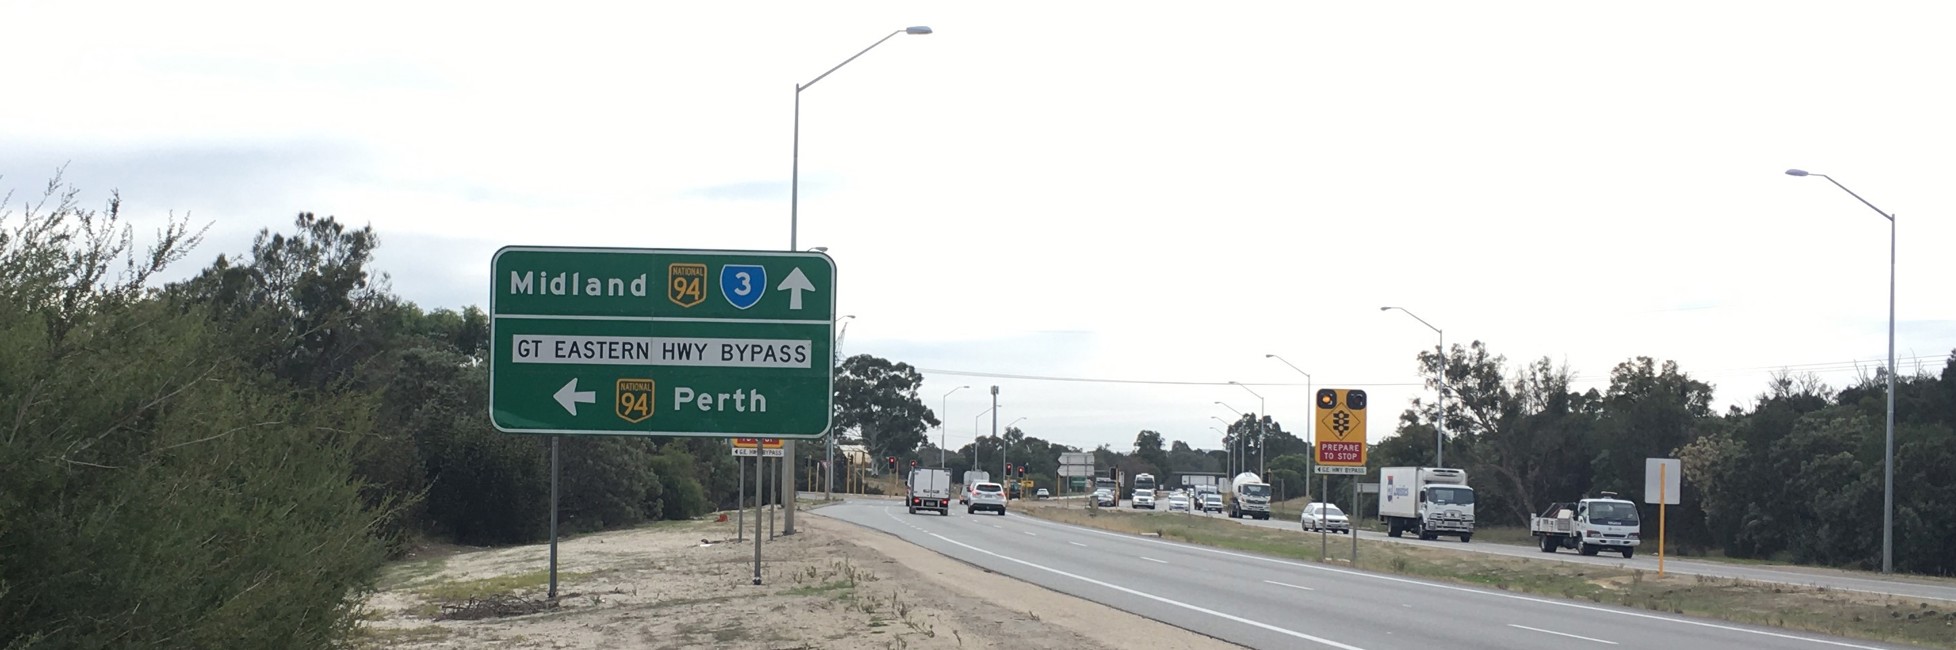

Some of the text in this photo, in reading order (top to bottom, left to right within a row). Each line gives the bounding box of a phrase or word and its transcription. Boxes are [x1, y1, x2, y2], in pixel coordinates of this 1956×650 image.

[673, 266, 703, 276] NATIONAL
[511, 271, 647, 297] Midland
[673, 278, 701, 300] 94
[734, 272, 752, 296] 3
[518, 340, 806, 363] GT EASTERN HWY BYPASS
[621, 382, 651, 391] NATIONAL
[621, 393, 648, 416] 94
[674, 387, 766, 412] Perth
[1322, 443, 1359, 452] PREPARE
[1324, 452, 1358, 460] TO STOP
